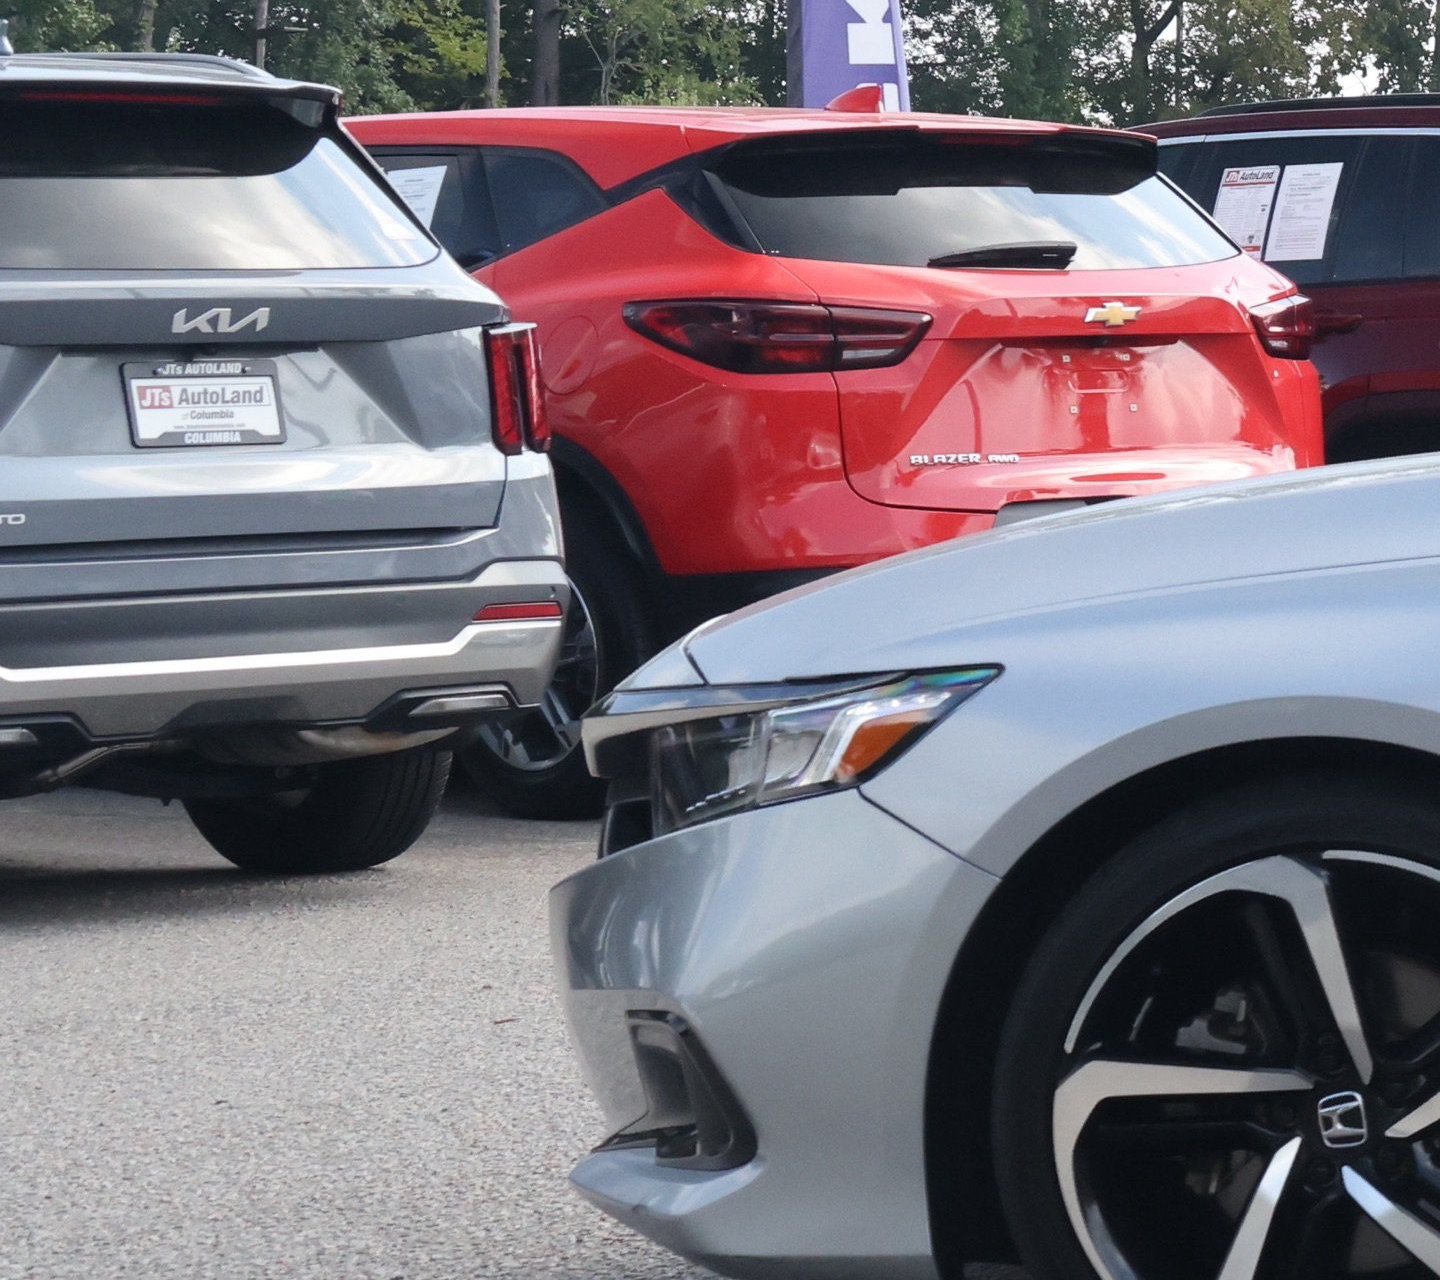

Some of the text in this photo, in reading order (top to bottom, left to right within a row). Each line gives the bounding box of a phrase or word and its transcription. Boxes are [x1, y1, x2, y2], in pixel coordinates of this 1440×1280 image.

[162, 363, 242, 375] JTs AUTOLAND
[140, 386, 264, 407] JTs AutoLand
[190, 410, 234, 420] Columbia
[184, 432, 241, 443] COLUMBIA
[909, 453, 1020, 465] BLAZER AWD
